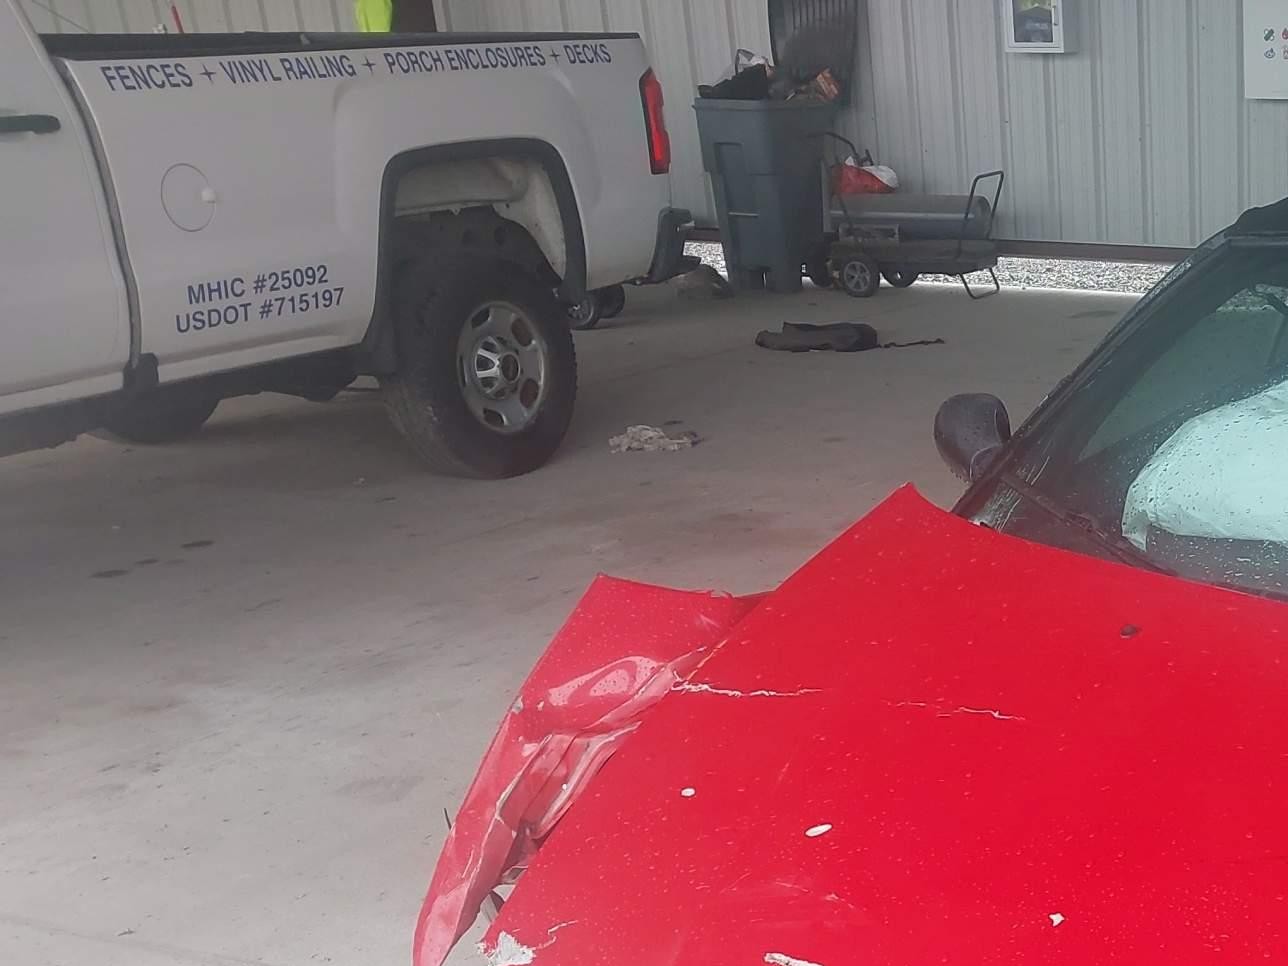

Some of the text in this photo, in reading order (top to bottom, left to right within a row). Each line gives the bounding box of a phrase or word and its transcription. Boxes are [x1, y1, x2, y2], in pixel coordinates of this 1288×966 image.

[100, 62, 193, 91] FENCES
[219, 59, 282, 84] VINYL
[280, 54, 357, 80] RAILING
[383, 49, 446, 74] PORCH
[443, 45, 546, 71] ENCLOSURES
[563, 43, 612, 64] DECKS
[187, 264, 328, 304] MHIC #25092
[175, 287, 344, 333] USDOT #715197
